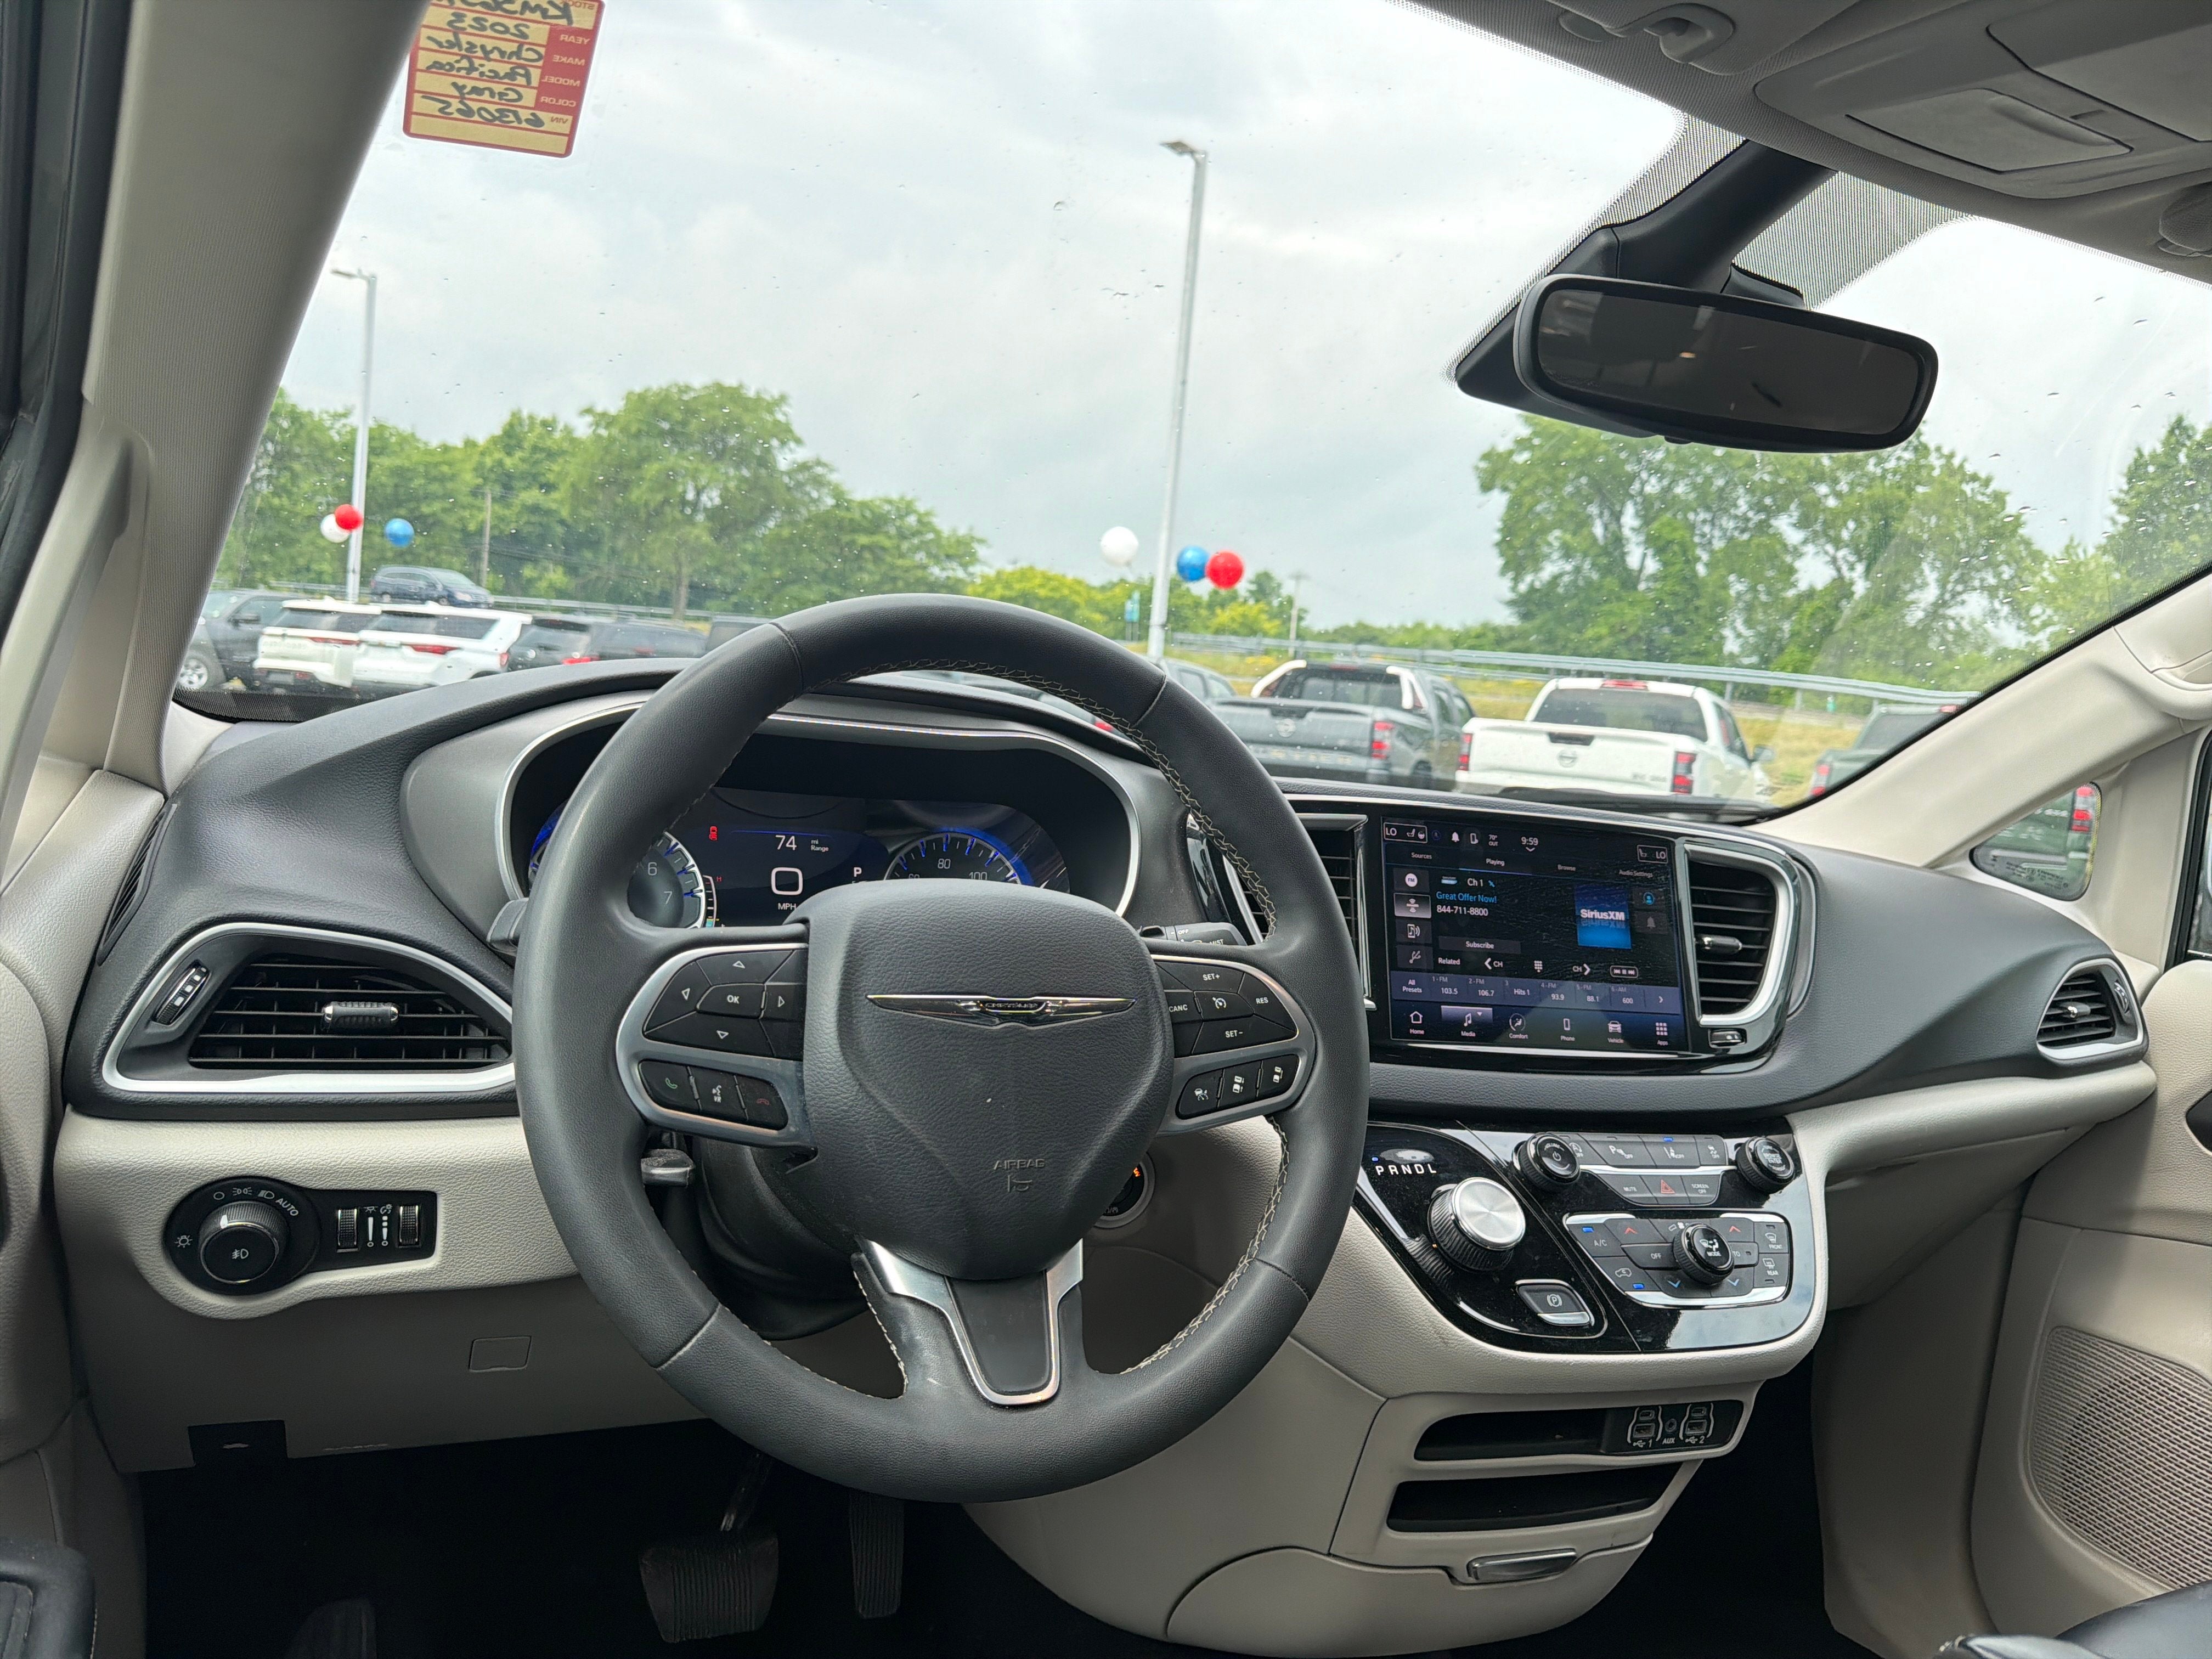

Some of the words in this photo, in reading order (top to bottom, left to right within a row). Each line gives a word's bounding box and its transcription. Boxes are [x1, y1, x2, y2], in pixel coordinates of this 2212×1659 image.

[1386, 827, 1397, 836] LO
[775, 835, 797, 850] 74
[1521, 837, 1538, 846] 9:59
[1656, 851, 1667, 860] LO
[938, 858, 951, 869] 80
[1486, 858, 1505, 867] Playing
[647, 862, 657, 876] 6
[854, 867, 862, 877] P
[1468, 878, 1478, 887] Ch
[663, 891, 673, 905] 7
[1436, 891, 1457, 900] Great
[1458, 893, 1476, 901] Offer
[1478, 894, 1497, 903] Now!
[1437, 905, 1488, 916] 844-711-8800
[1580, 909, 1625, 921] SiriusXM
[1466, 941, 1494, 949] Subscribe
[727, 995, 740, 1004] OK
[1169, 1005, 1188, 1013] CANC
[994, 1158, 1045, 1170] AIRBAG
[275, 1197, 299, 1216] AUTO
[1594, 1239, 1607, 1248] A/C
